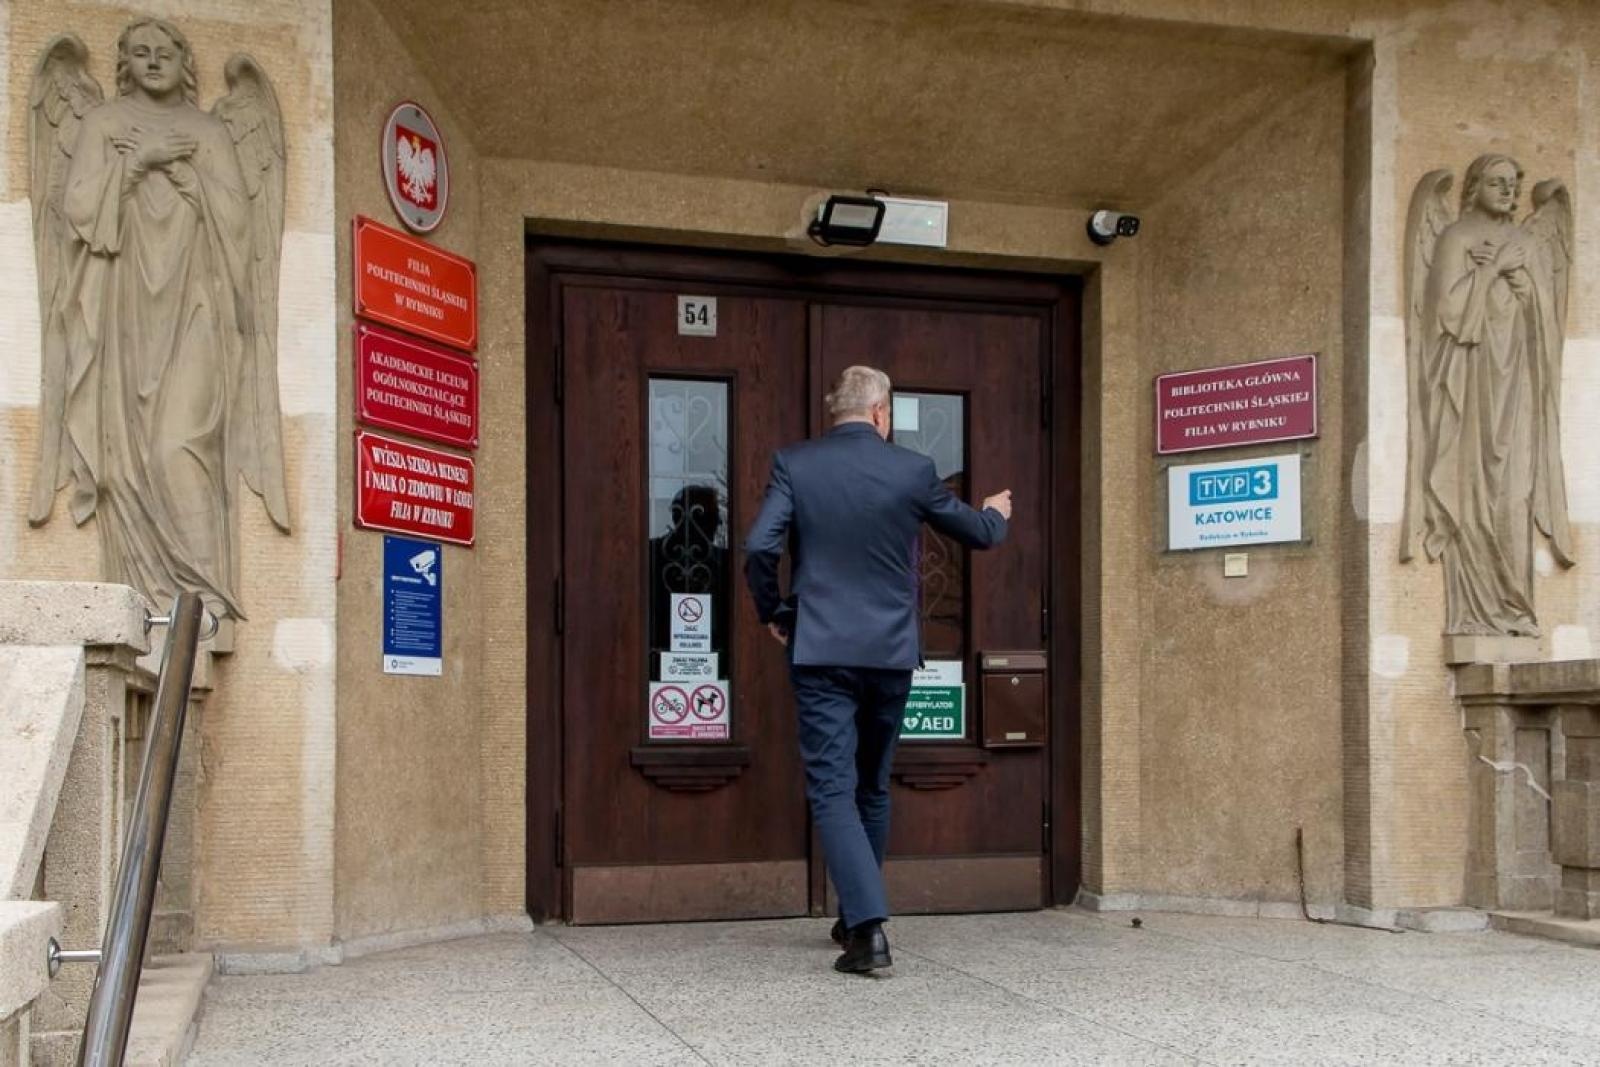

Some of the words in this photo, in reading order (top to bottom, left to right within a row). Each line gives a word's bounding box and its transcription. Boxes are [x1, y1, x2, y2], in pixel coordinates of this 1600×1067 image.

[366, 262, 431, 296] POLITECHNIKI
[407, 258, 431, 277] FILIA
[395, 293, 404, 306] W
[406, 297, 444, 320] RYBNIKU
[685, 302, 708, 325] 54
[370, 351, 434, 380] AKADEMICKIE
[436, 370, 469, 391] LICEUM
[1171, 378, 1243, 397] BIBLIOTEKA
[1244, 371, 1301, 388] GŁÓWNA
[372, 370, 465, 407] OGÓLNOKSZTAŁCĄCE
[366, 387, 432, 416] POLITECHNIKI
[434, 404, 471, 428] ŚLĄSKIEJ
[1164, 400, 1249, 419] POLITECHNIKI
[1251, 391, 1310, 409] ŚLĄSKIEJ
[1184, 424, 1216, 437] FILIA
[1217, 422, 1230, 433] W
[1231, 416, 1287, 432] RYBNIKU
[372, 444, 407, 470] WYŻSZA
[365, 470, 370, 488] I
[372, 472, 397, 492] NAUK
[399, 476, 406, 494] O
[445, 487, 452, 503] W
[1201, 476, 1245, 496] TVP
[1253, 470, 1272, 495] 3
[390, 500, 411, 519] FILIA
[413, 504, 422, 521] W
[1195, 507, 1272, 525] KATOWICE
[921, 717, 954, 731] AED
